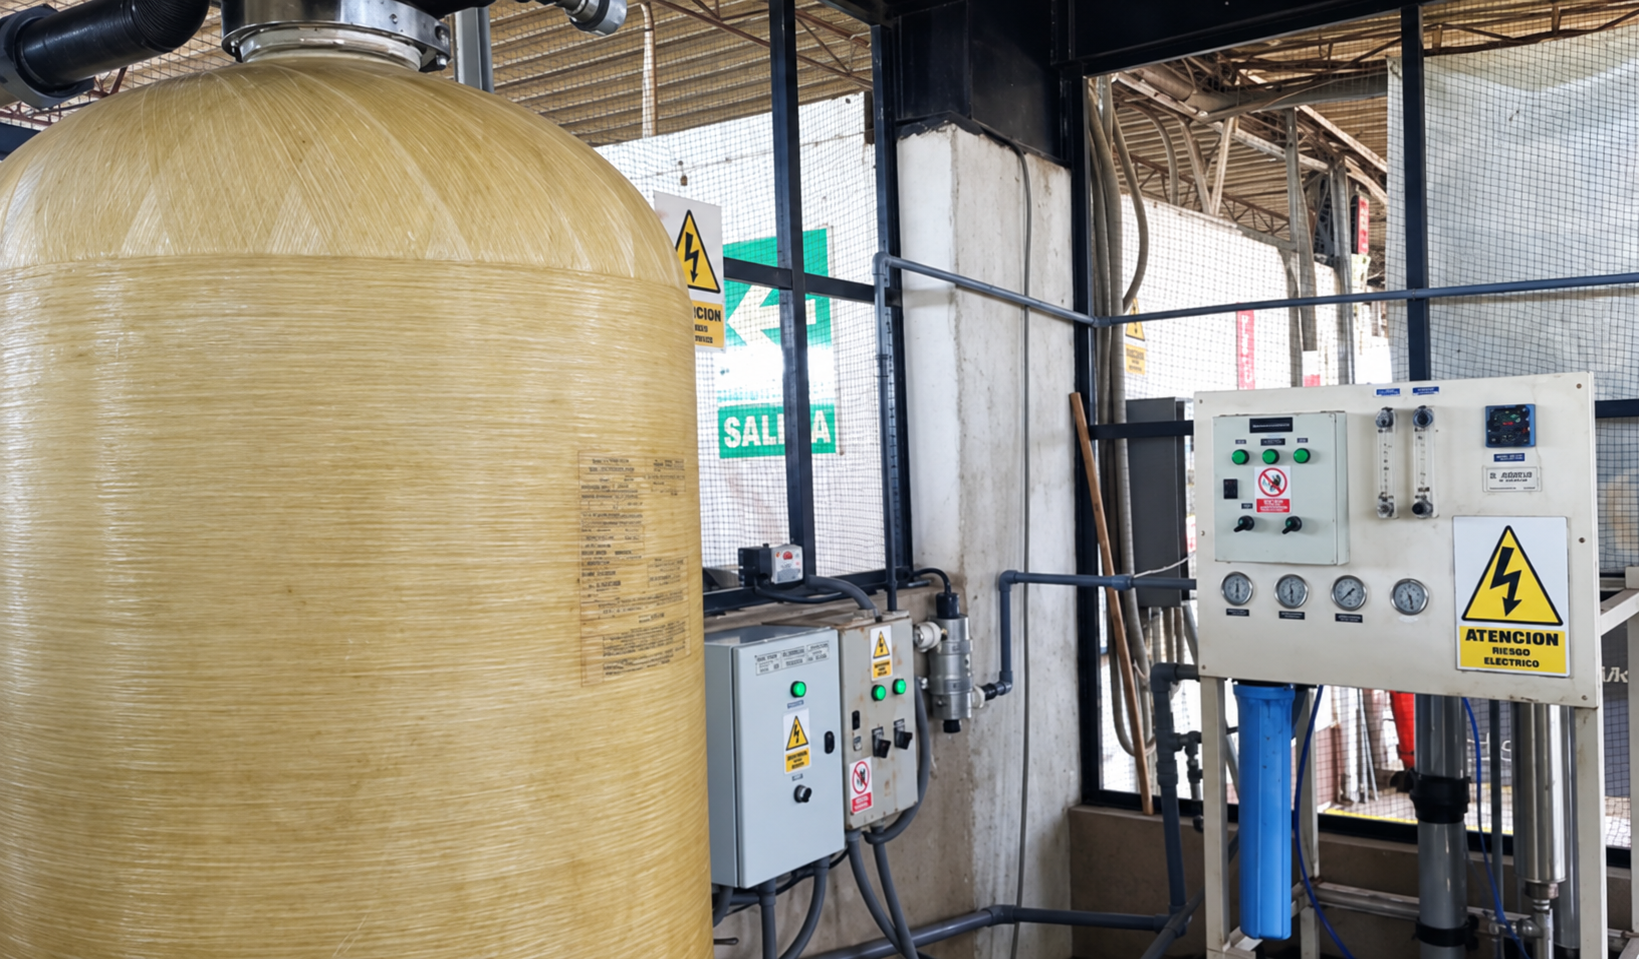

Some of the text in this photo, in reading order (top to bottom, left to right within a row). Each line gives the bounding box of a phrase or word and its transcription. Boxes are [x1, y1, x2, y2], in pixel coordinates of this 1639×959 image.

[724, 410, 831, 448] SALIA
[1465, 629, 1559, 646] ATENCION
[1492, 647, 1530, 656] RIESGO
[1484, 657, 1540, 668] ELECTRICO
